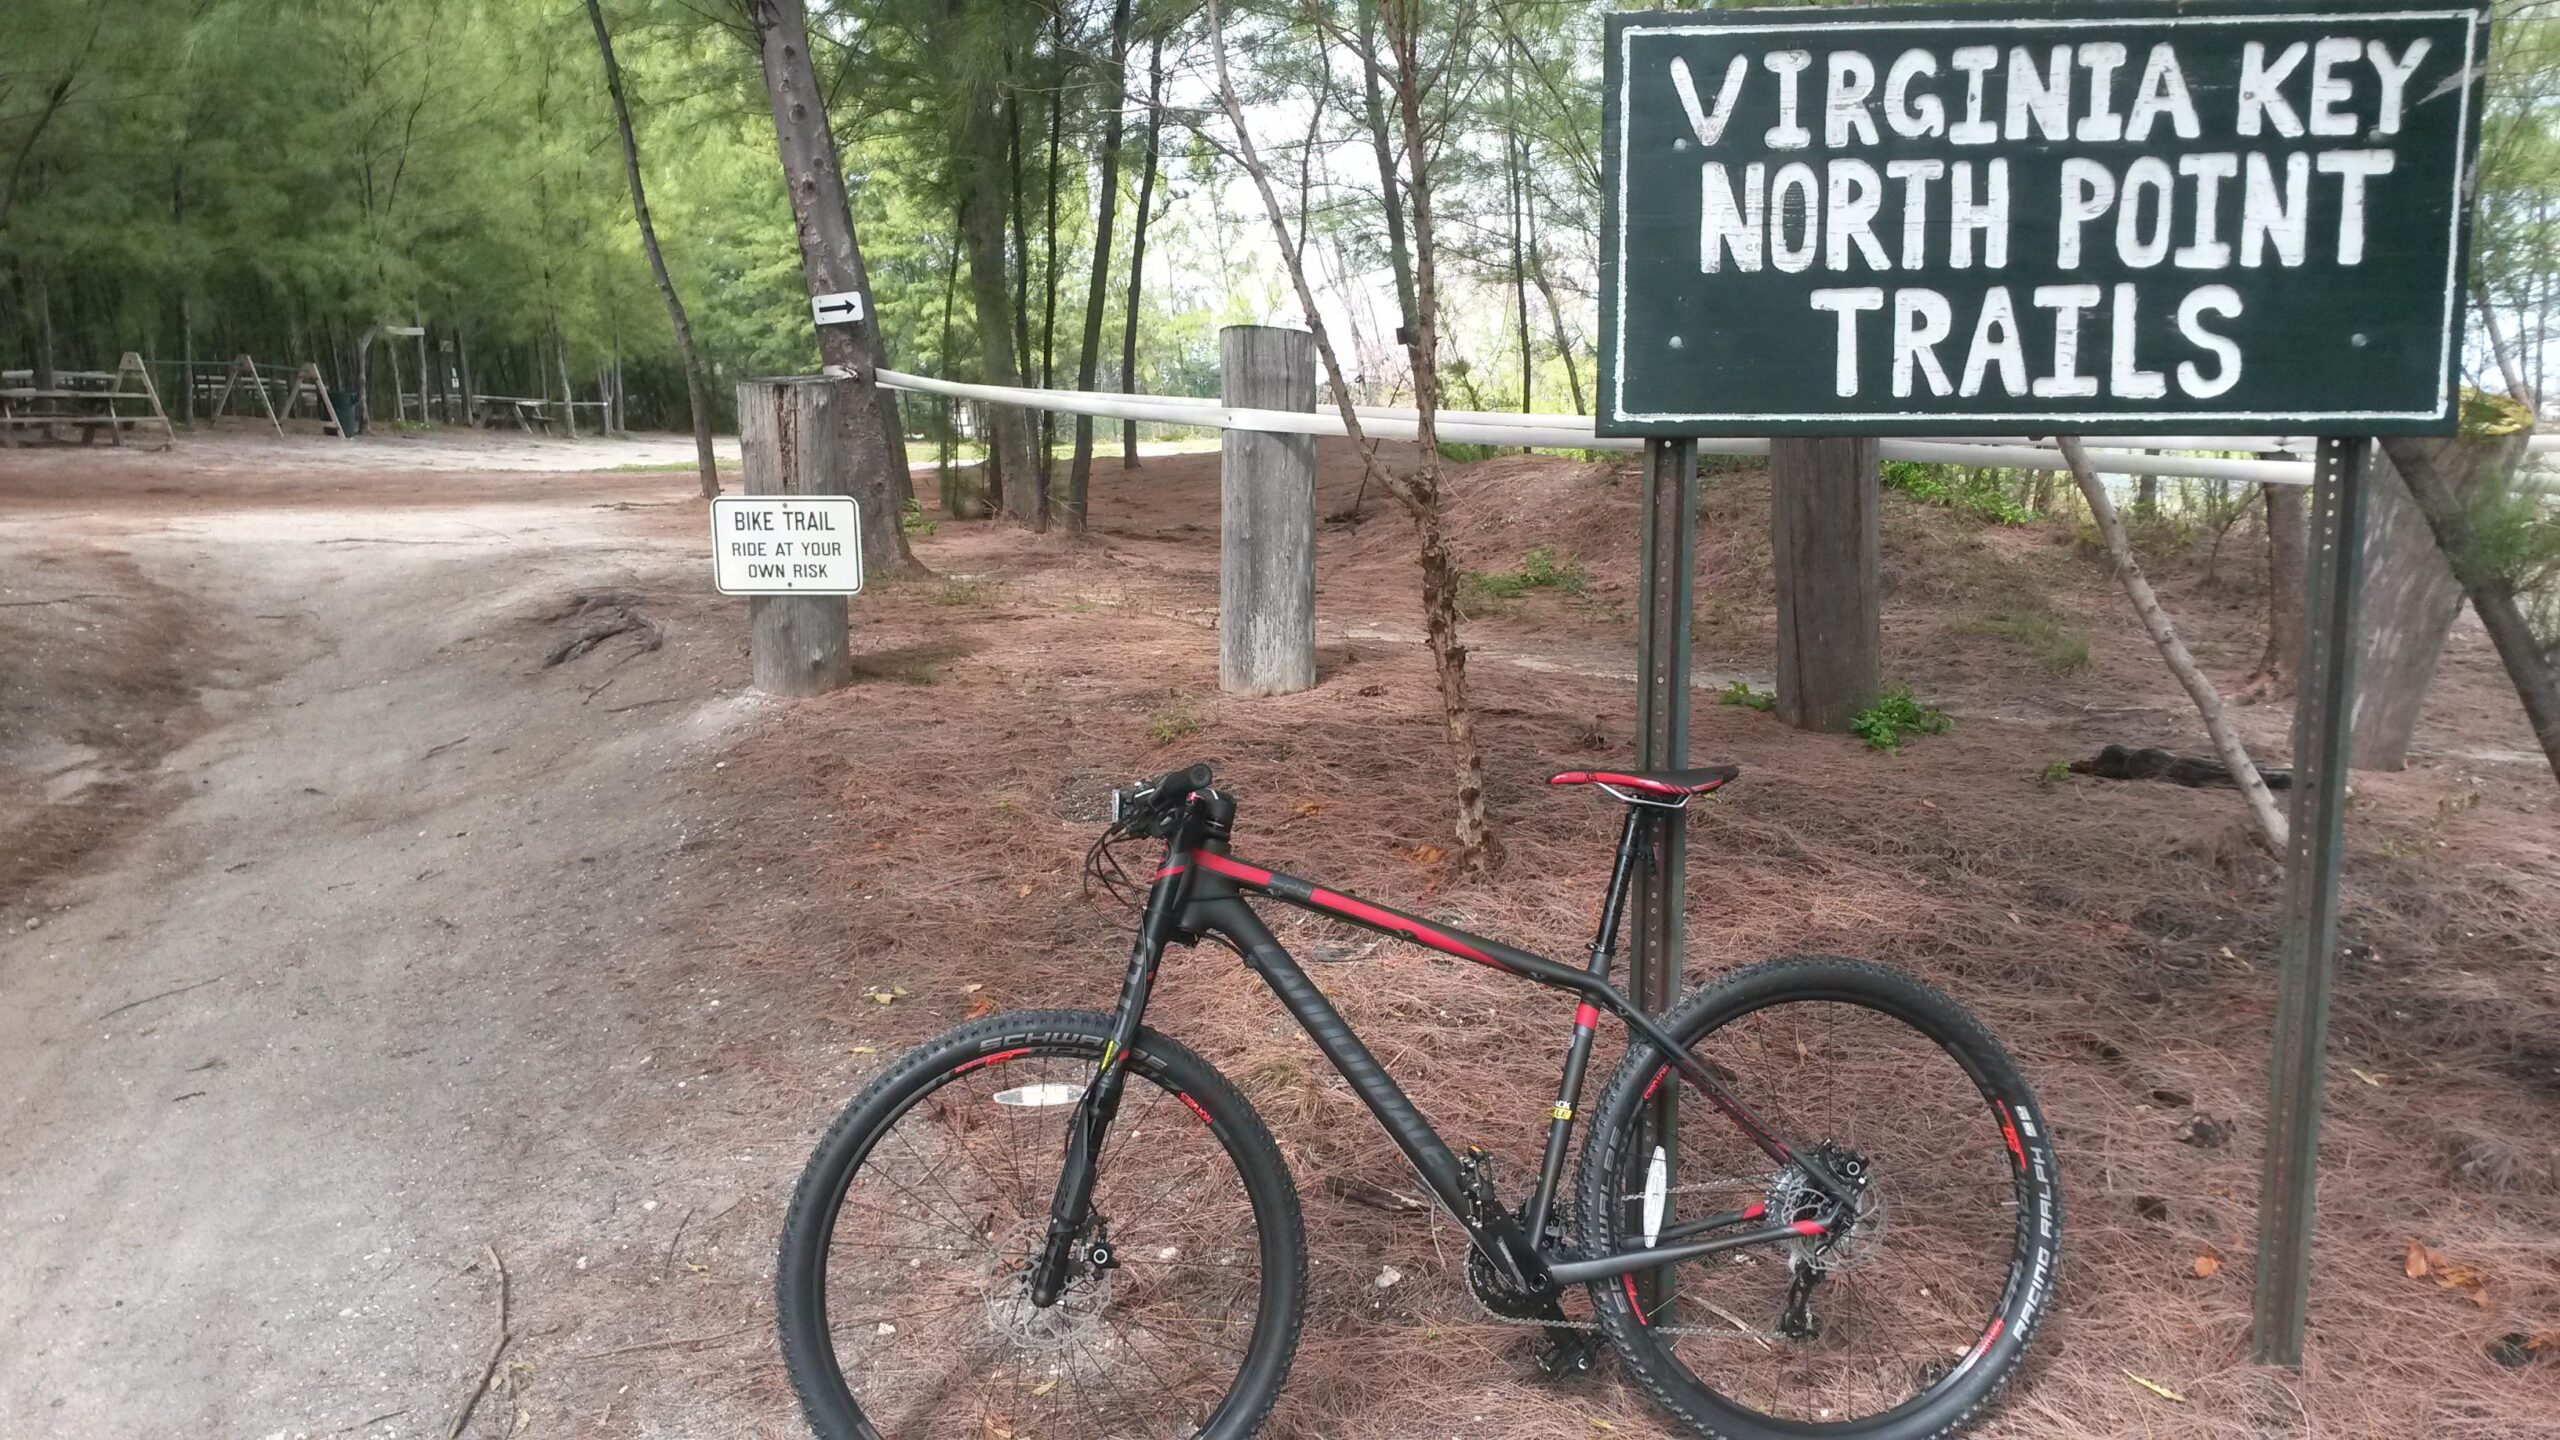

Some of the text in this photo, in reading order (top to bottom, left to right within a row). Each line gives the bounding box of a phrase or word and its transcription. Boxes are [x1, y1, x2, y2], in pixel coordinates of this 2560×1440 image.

[1670, 37, 2432, 149] VIRGINIA KEY
[1700, 149, 2394, 274] NORTH POINT
[1810, 283, 2243, 399] TRAILS
[732, 542, 842, 557] RIDE AT YOUR
[734, 511, 835, 531] BIKE TRAIL
[749, 564, 828, 578] OWN RISK
[980, 1032, 1168, 1070] SCHWABE
[2012, 1147, 2053, 1342] RACING RALPH
